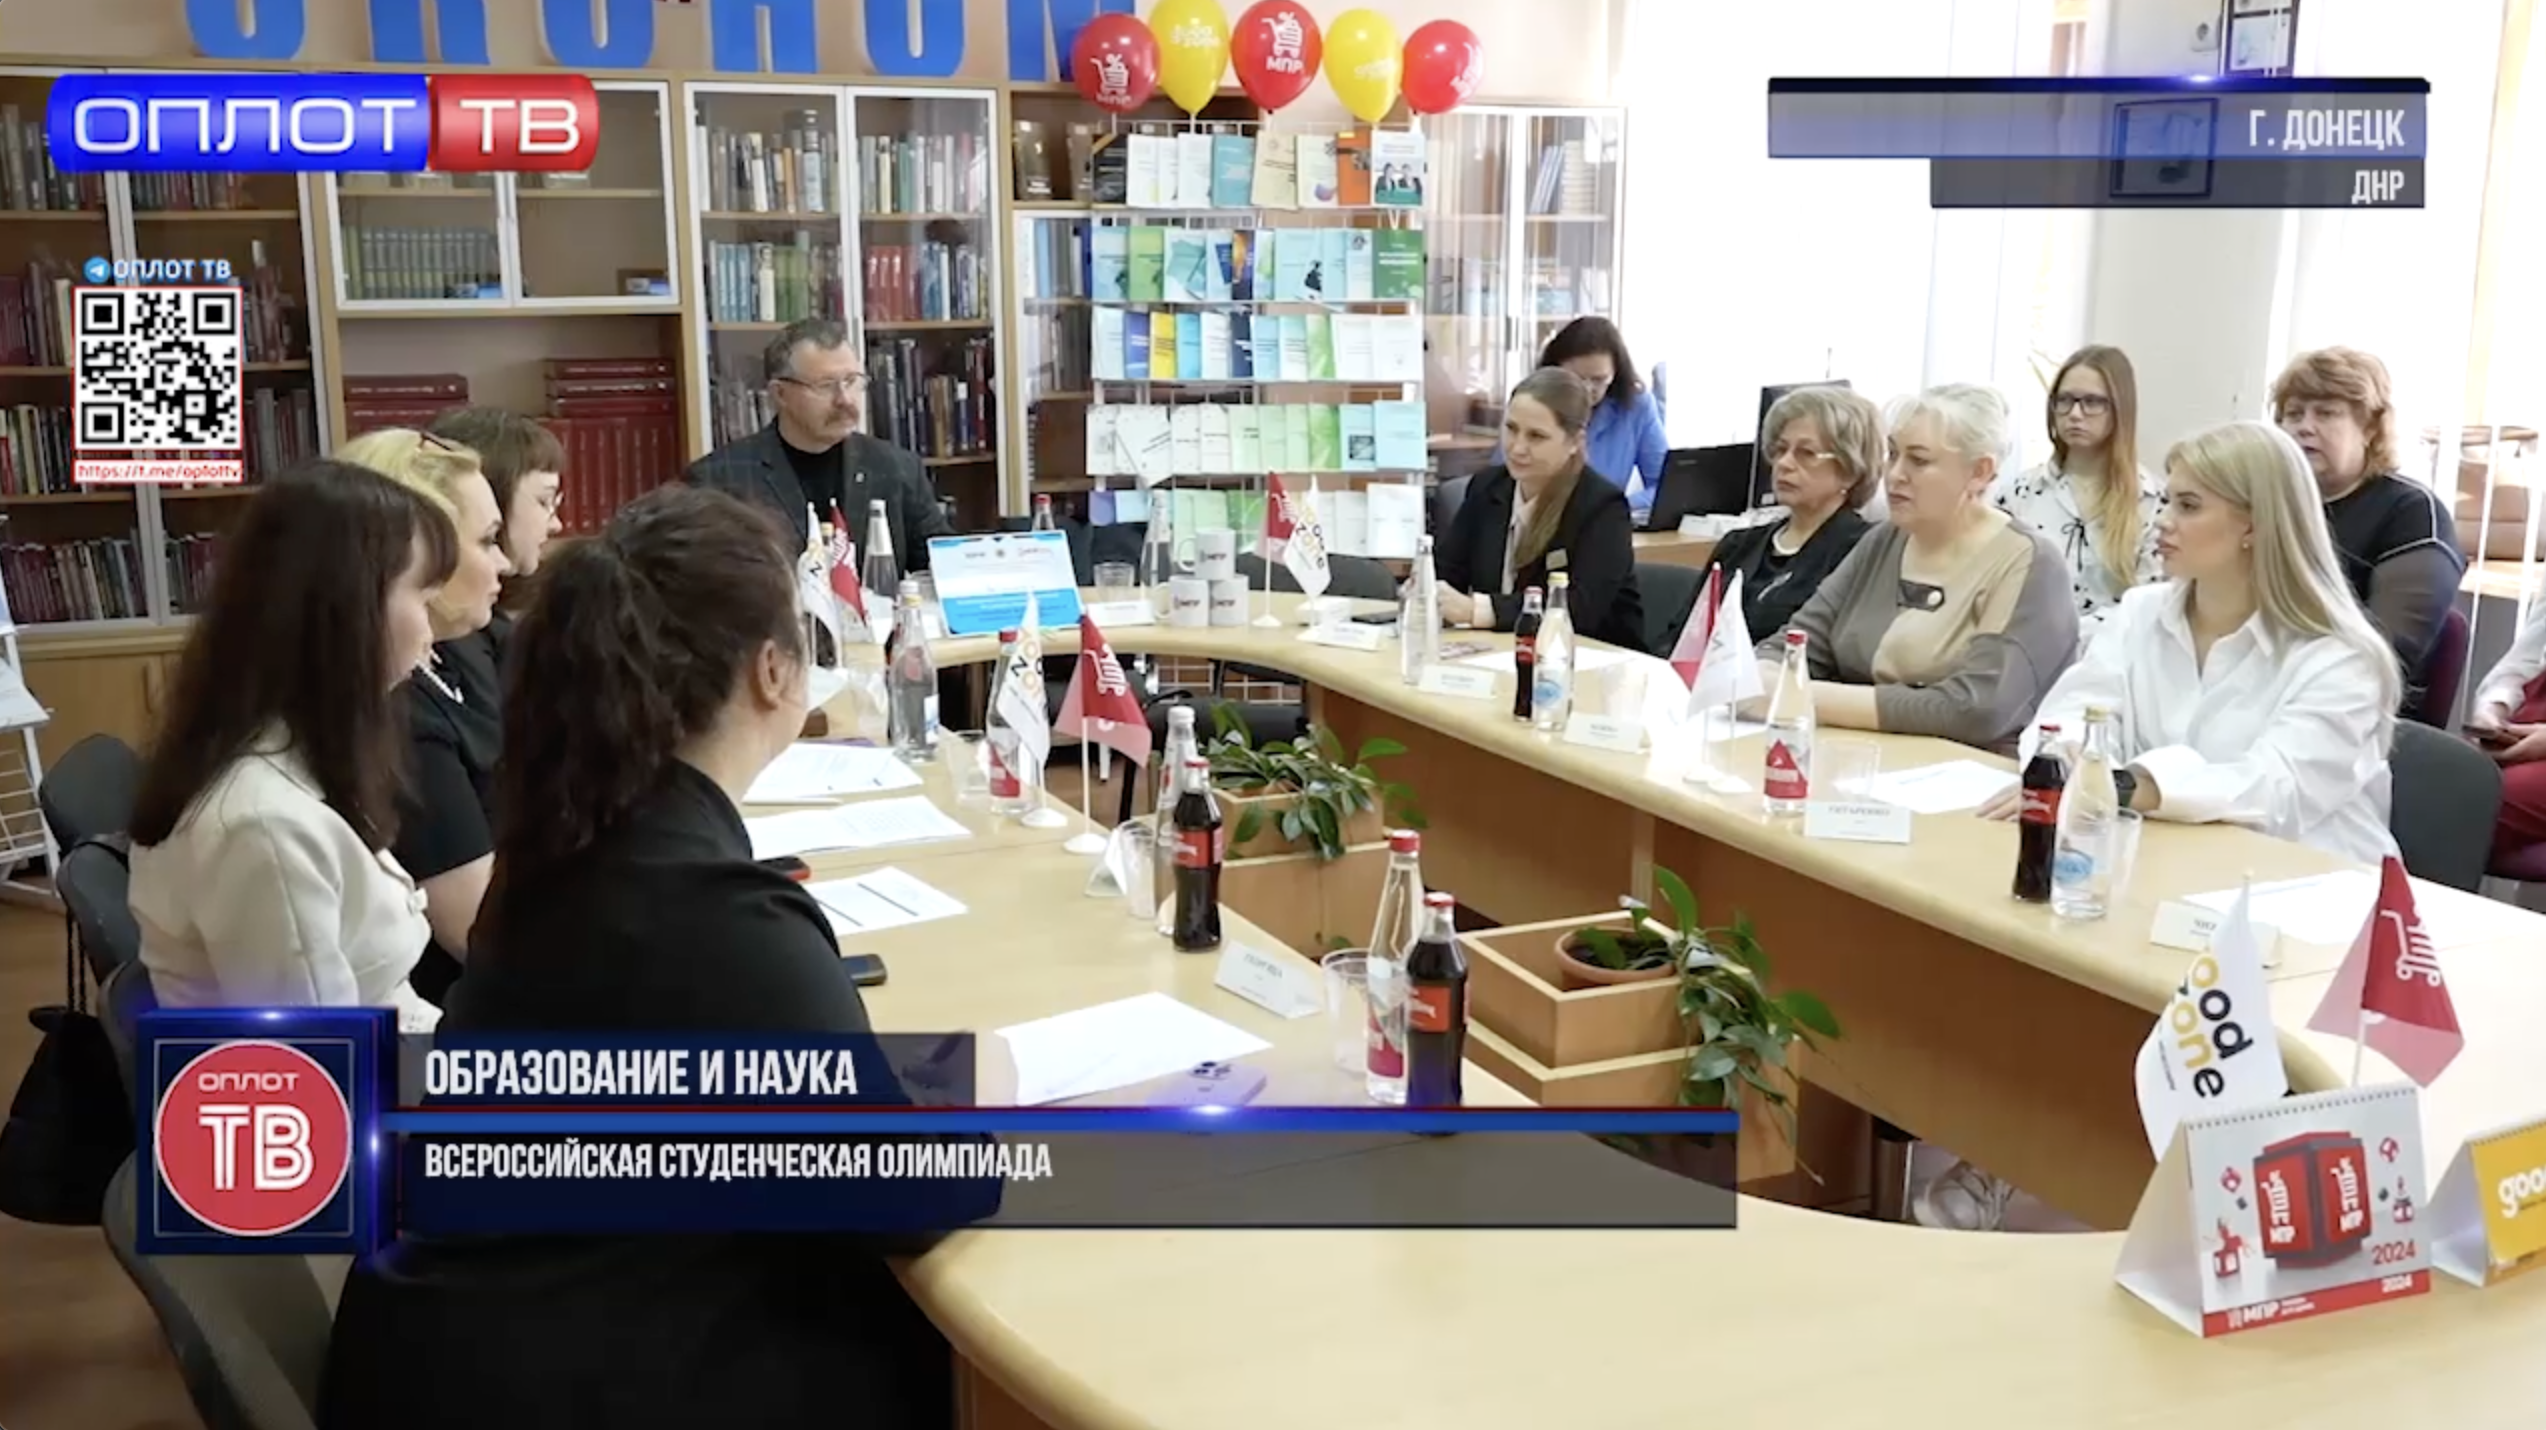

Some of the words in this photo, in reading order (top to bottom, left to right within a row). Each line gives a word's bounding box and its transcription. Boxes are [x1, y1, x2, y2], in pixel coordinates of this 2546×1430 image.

[1266, 56, 1304, 74] МПР
[2497, 1166, 2546, 1219] goo
[2372, 1239, 2416, 1266] 2024
[2382, 1274, 2413, 1293] 2024
[2243, 1302, 2279, 1323] МПР
